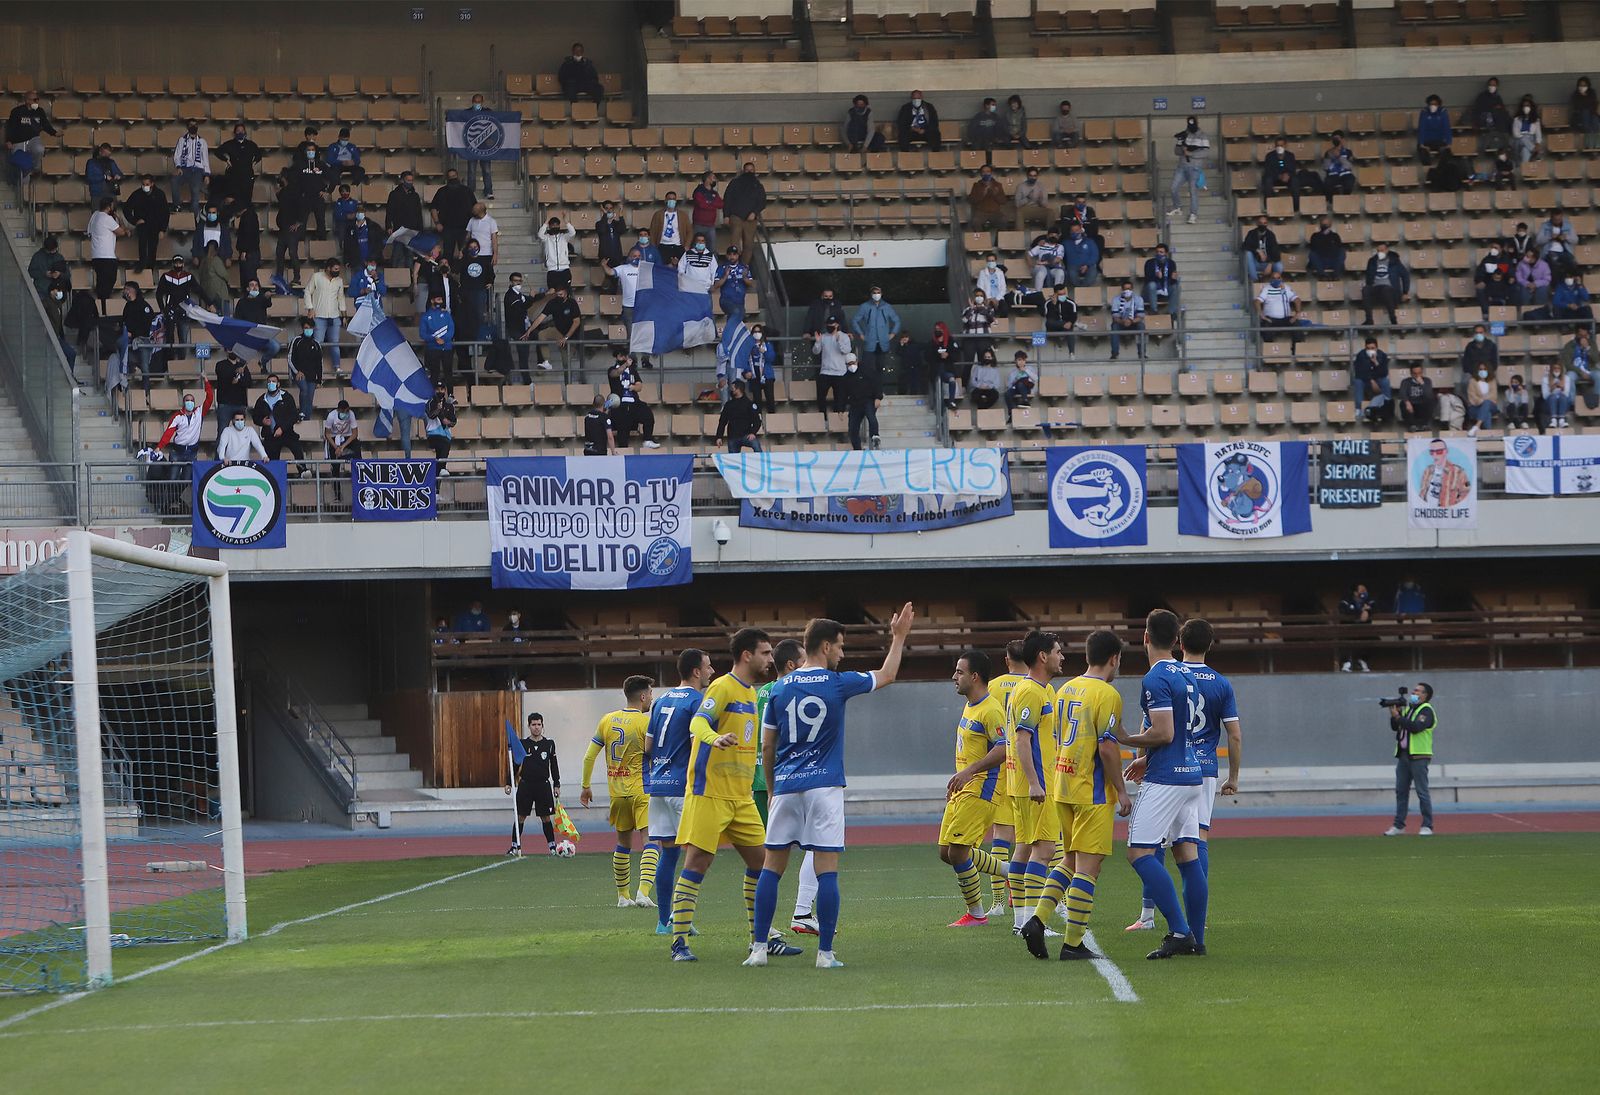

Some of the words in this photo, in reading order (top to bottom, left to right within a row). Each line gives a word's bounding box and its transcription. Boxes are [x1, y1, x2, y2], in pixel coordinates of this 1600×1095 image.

[817, 244, 859, 258] Cajasol
[196, 348, 209, 356] 210
[1332, 440, 1370, 454] MAITE
[356, 462, 431, 485] NEW
[716, 450, 887, 494] FUERZA
[904, 447, 998, 493] CRIS
[1324, 464, 1377, 480] SIEMPRE
[358, 487, 432, 510] ONES
[502, 477, 616, 506] ANIMAR
[624, 480, 640, 504] A
[647, 478, 678, 502] TU
[1320, 488, 1381, 503] PRESENTE
[501, 510, 590, 538] EQUIPO
[595, 506, 636, 538] NO
[643, 504, 680, 537] ES
[753, 506, 786, 521] Xerez
[791, 511, 848, 524] Deportivo
[853, 513, 892, 524] contra
[896, 511, 907, 523] el
[911, 508, 947, 523] futbol
[952, 498, 1001, 517] moderno
[1414, 508, 1449, 518] CHOOSE
[1451, 508, 1470, 518] LIFE
[211, 528, 267, 544] ANTIFASCISTA
[503, 546, 535, 571] UN
[542, 543, 642, 572] DELITO
[658, 706, 676, 748] 7
[785, 696, 828, 743] 19
[1058, 699, 1082, 748] 15
[611, 726, 625, 762] 2
